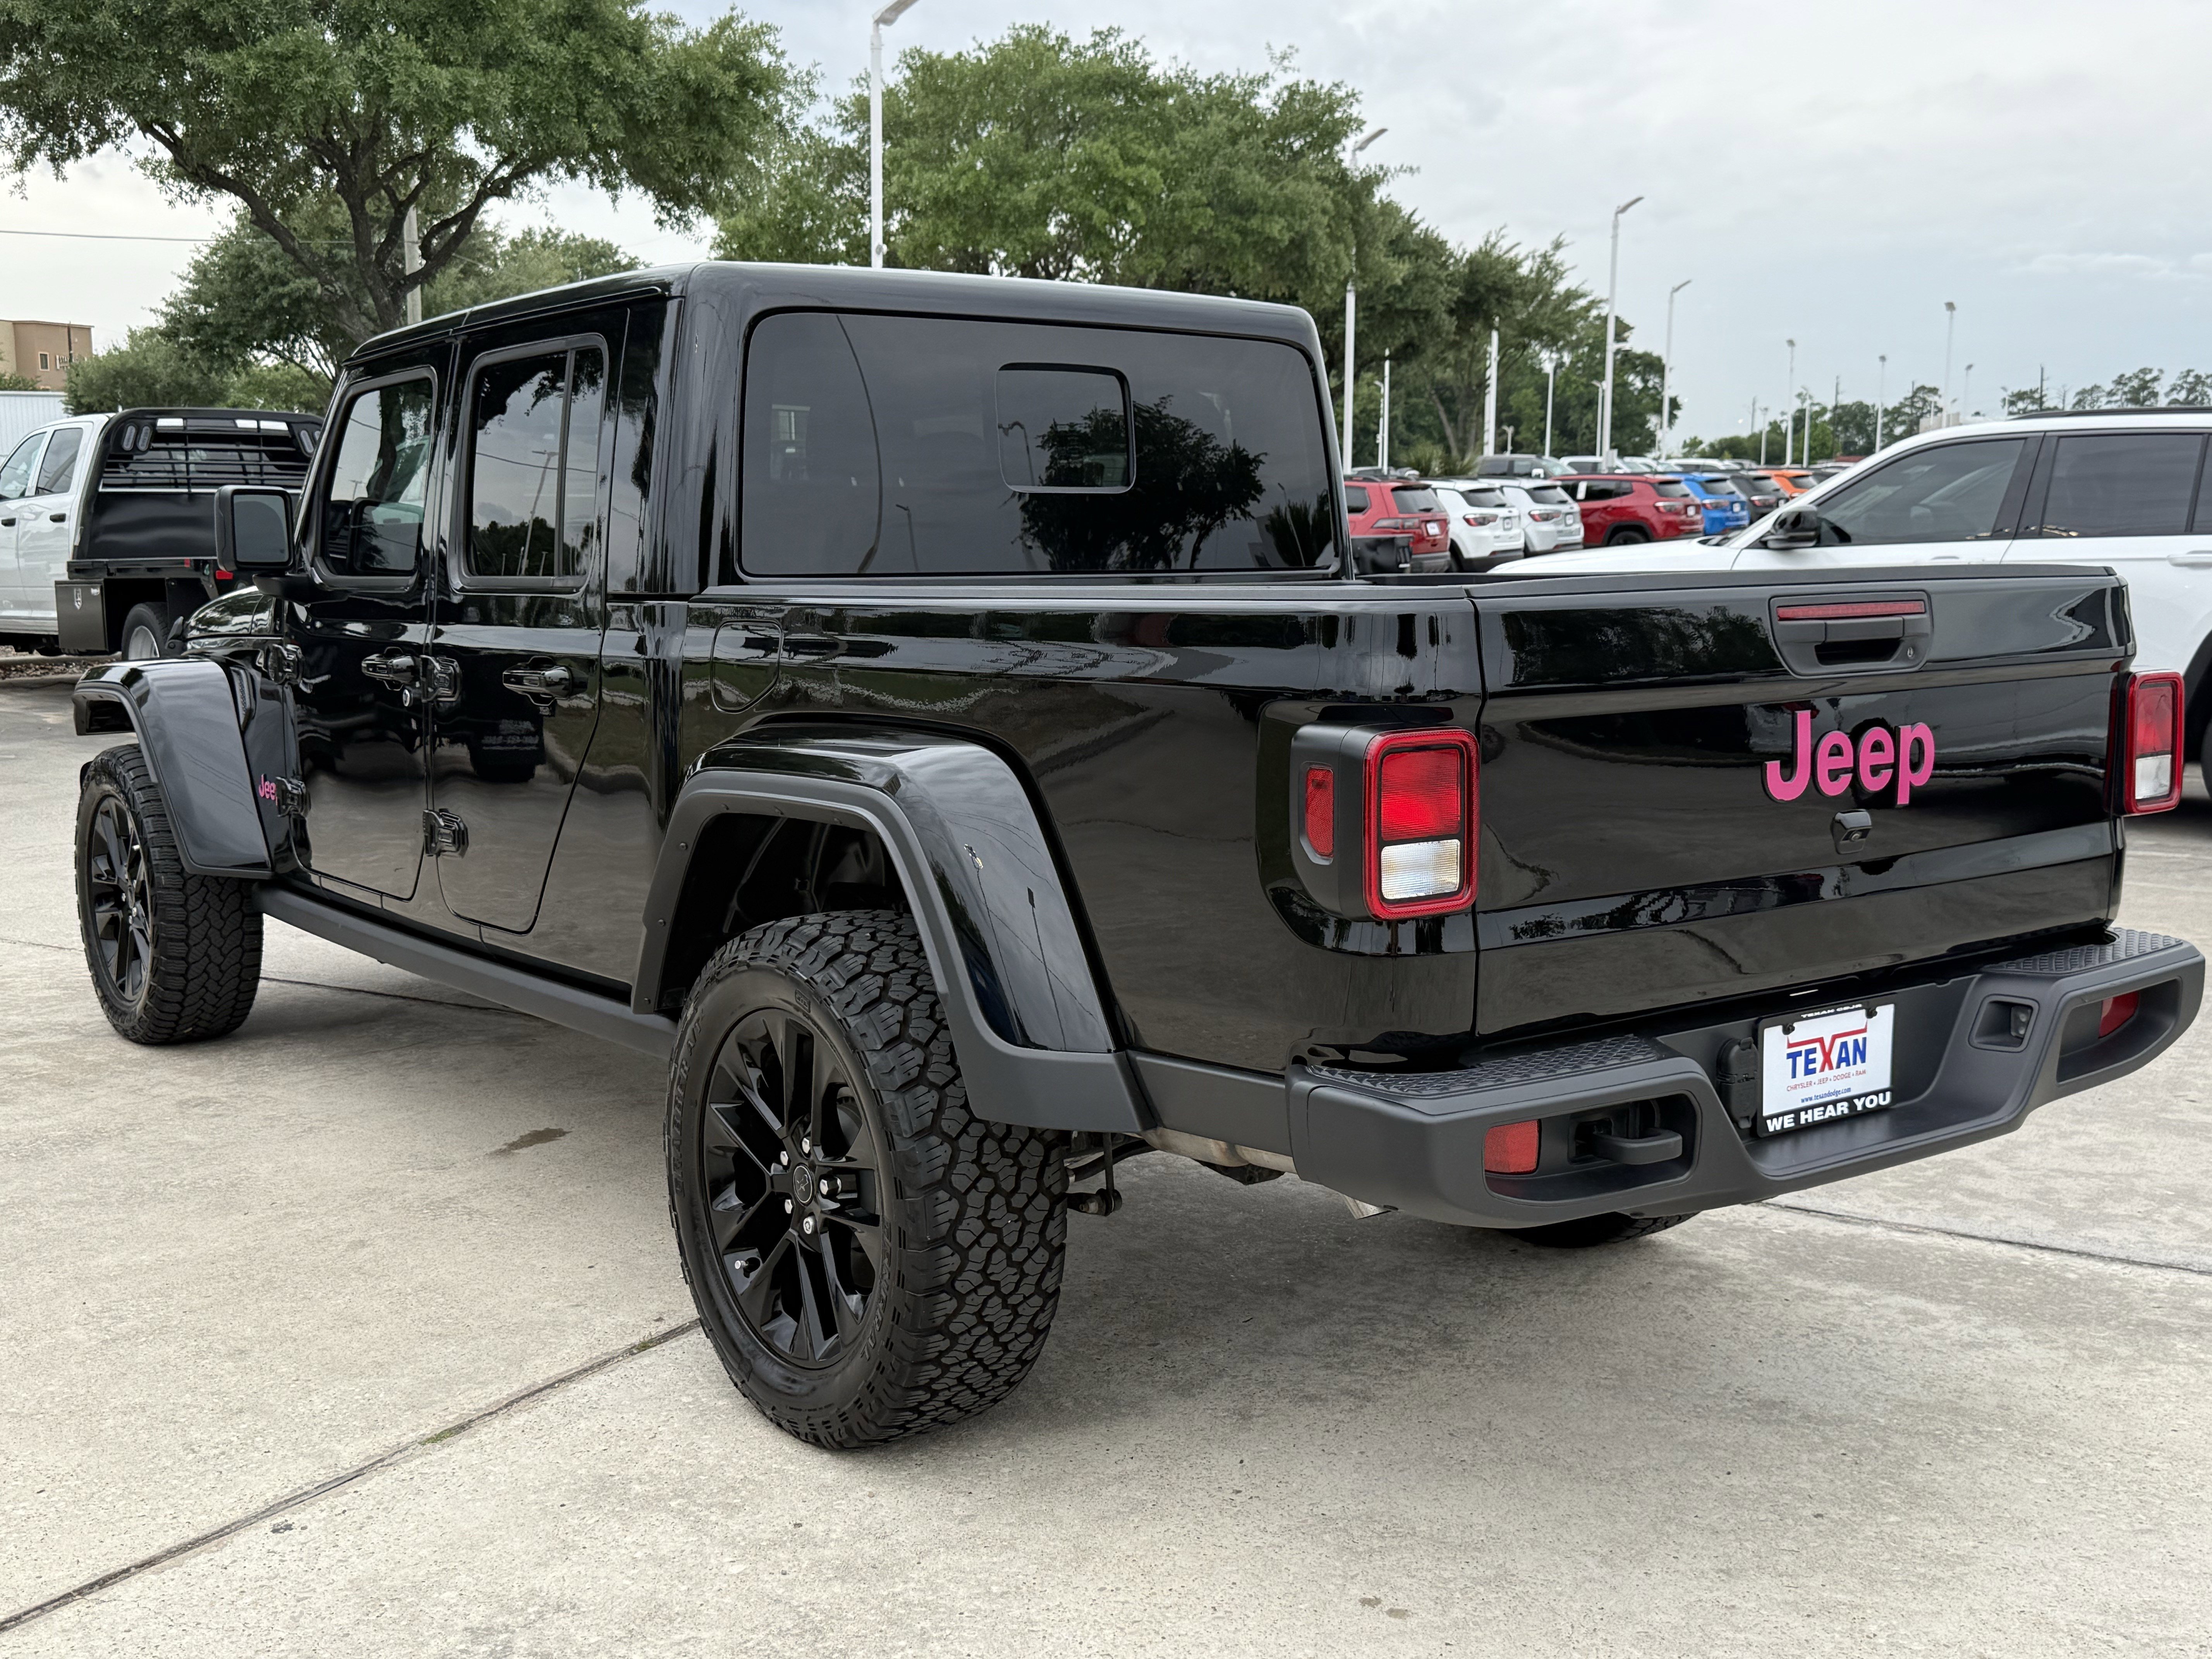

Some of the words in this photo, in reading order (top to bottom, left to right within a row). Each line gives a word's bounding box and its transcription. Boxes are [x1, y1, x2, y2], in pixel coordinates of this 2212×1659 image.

[1763, 709, 1935, 806] Jeep
[259, 774, 278, 806] Jee
[1786, 1035, 1867, 1079] TEXAN
[1786, 1080, 1812, 1092] CHRYSLER
[1817, 1077, 1829, 1085] JEEP
[1833, 1072, 1851, 1081] DODGE
[1801, 1087, 1851, 1103] www.texandodge.com
[1766, 1114, 1795, 1132] WE
[1800, 1103, 1849, 1125] HEAR
[1854, 1091, 1891, 1111] YOU
